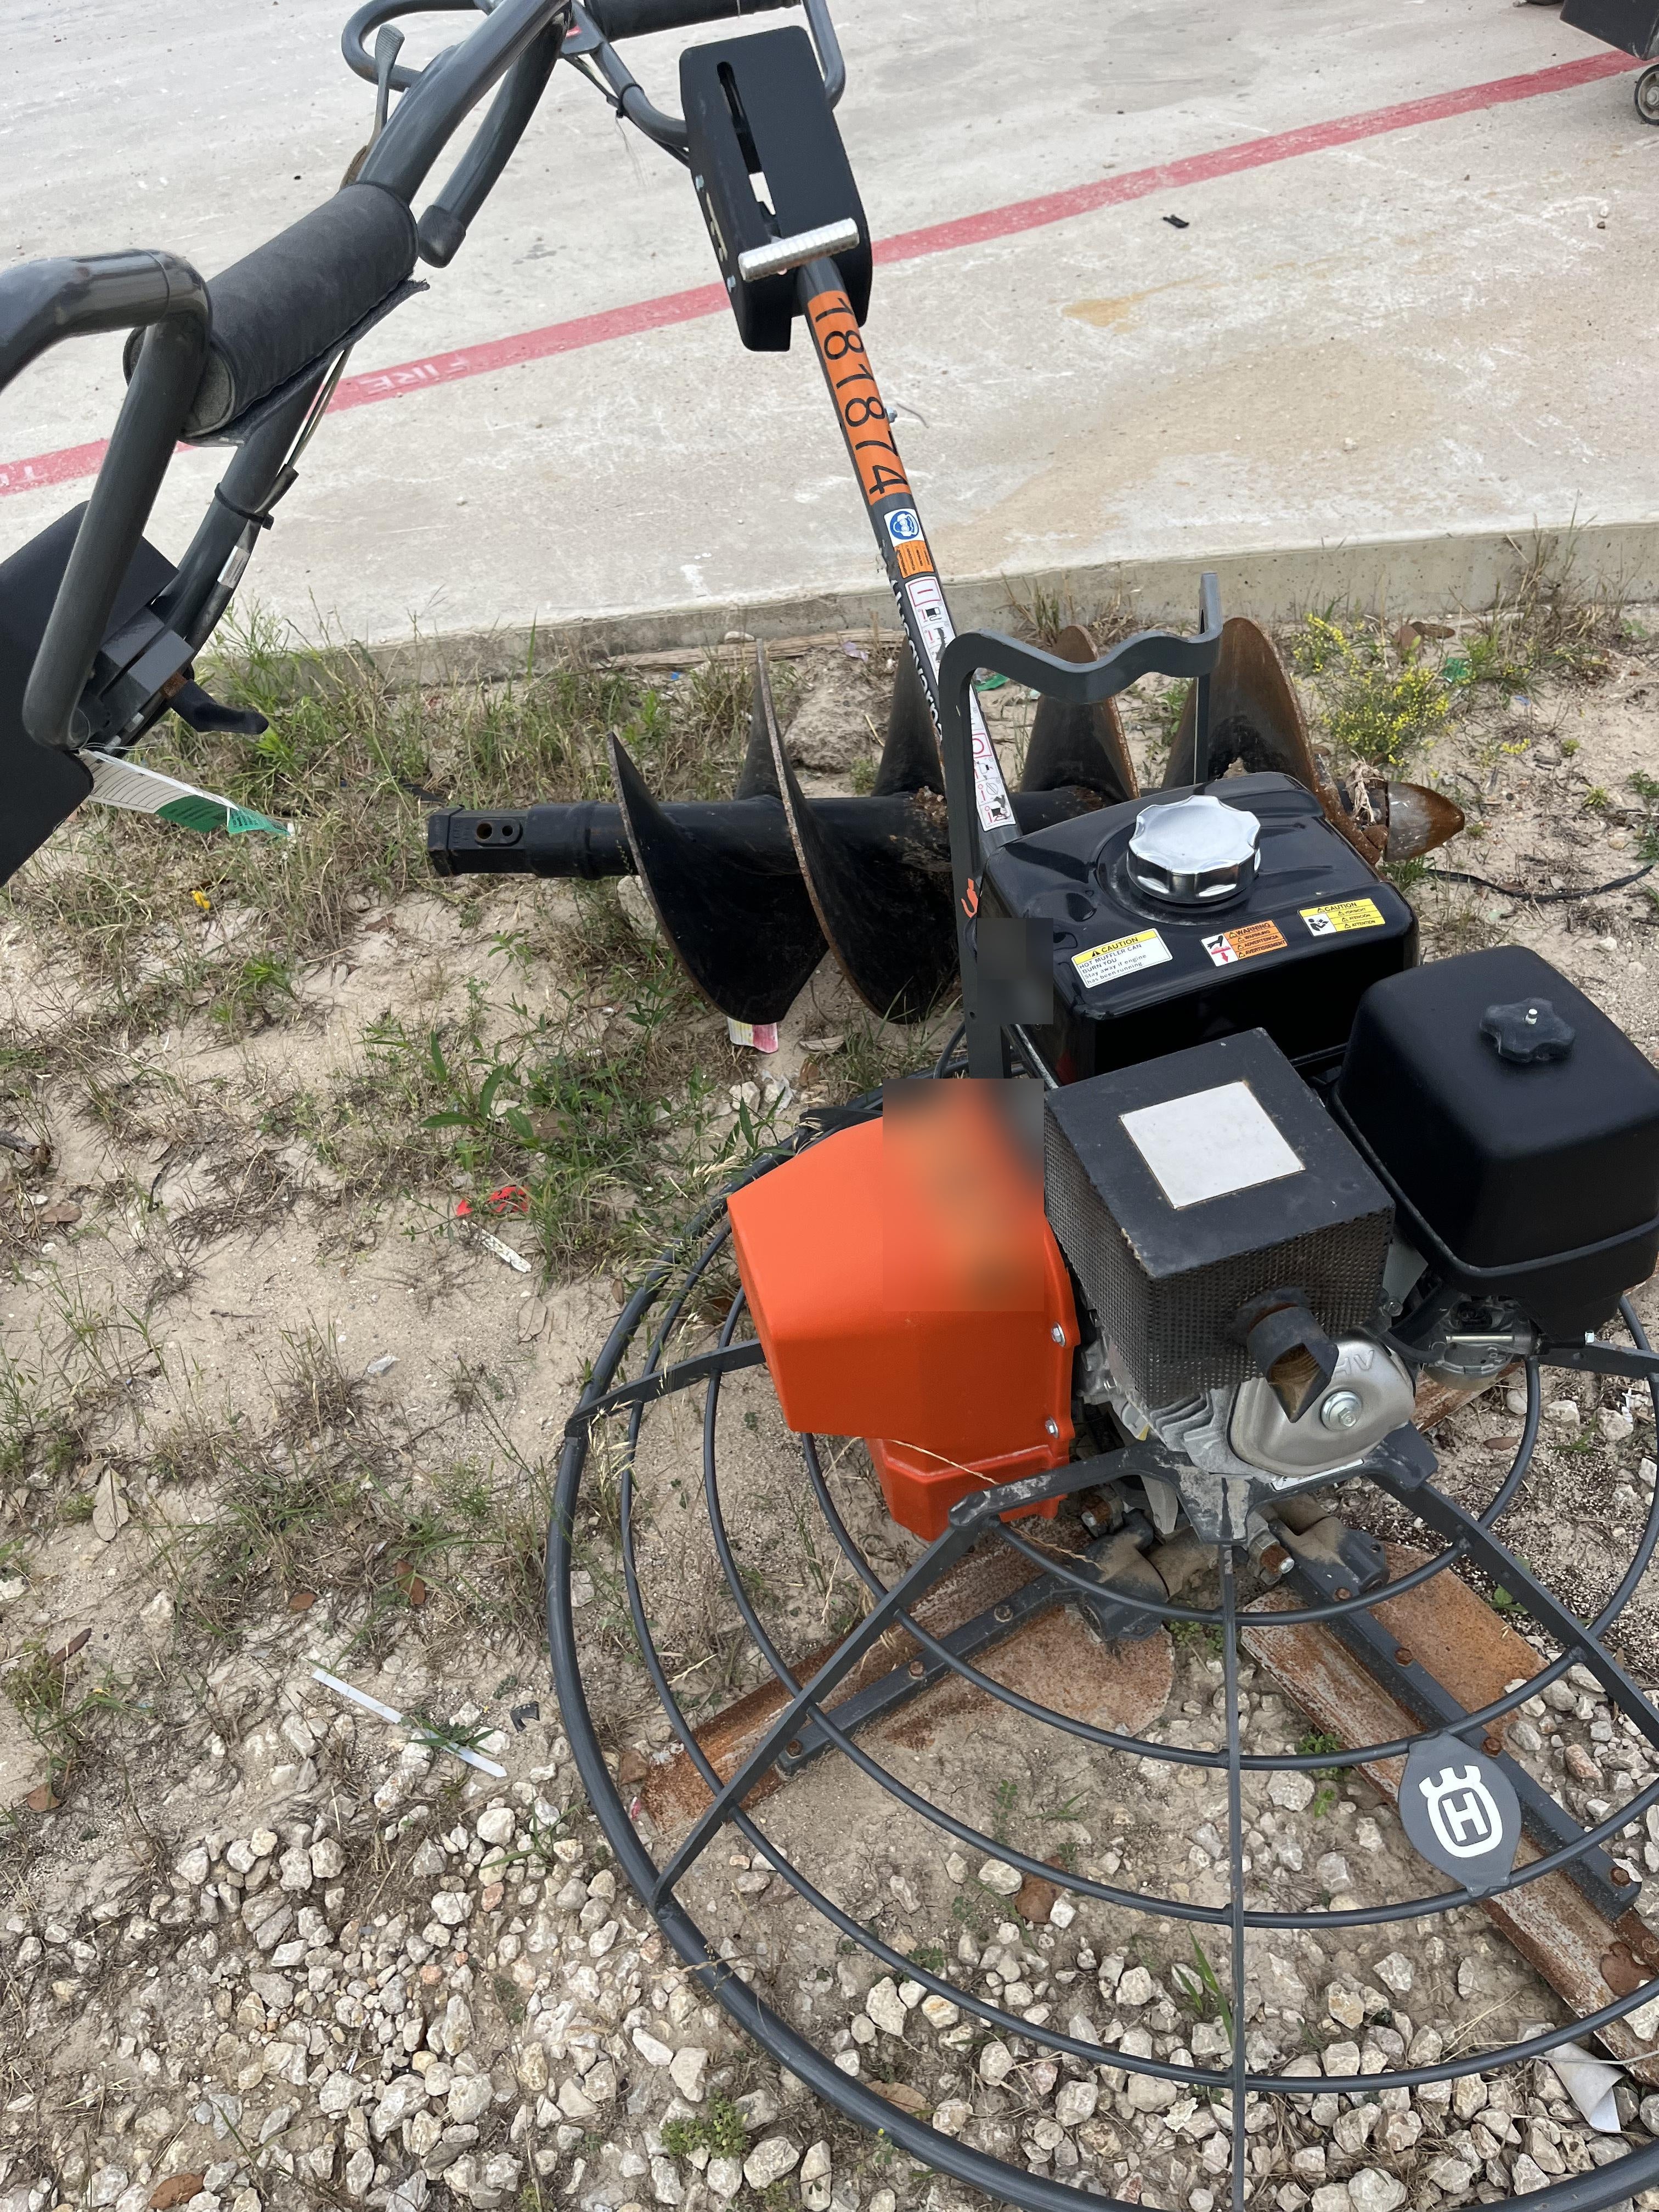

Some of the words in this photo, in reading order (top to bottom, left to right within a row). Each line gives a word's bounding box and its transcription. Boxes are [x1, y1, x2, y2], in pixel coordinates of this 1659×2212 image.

[359, 354, 470, 395] FIRE
[815, 298, 909, 495] 181874
[1324, 902, 1358, 912] CAUTION
[1235, 922, 1271, 935] WARNING
[1101, 936, 1138, 953] CAUTION
[1244, 935, 1279, 947] ADVERTENCIA
[1245, 940, 1286, 955] AVERTISSEMENT
[1079, 961, 1093, 969] HOT
[1094, 949, 1126, 963] MUFFLER
[1127, 943, 1142, 952] CAN
[1082, 964, 1102, 974] BURN
[1103, 957, 1118, 966] YOU
[1084, 971, 1098, 979] Stay
[1100, 965, 1116, 973] away
[1124, 953, 1147, 964] engine
[1099, 971, 1116, 980] been
